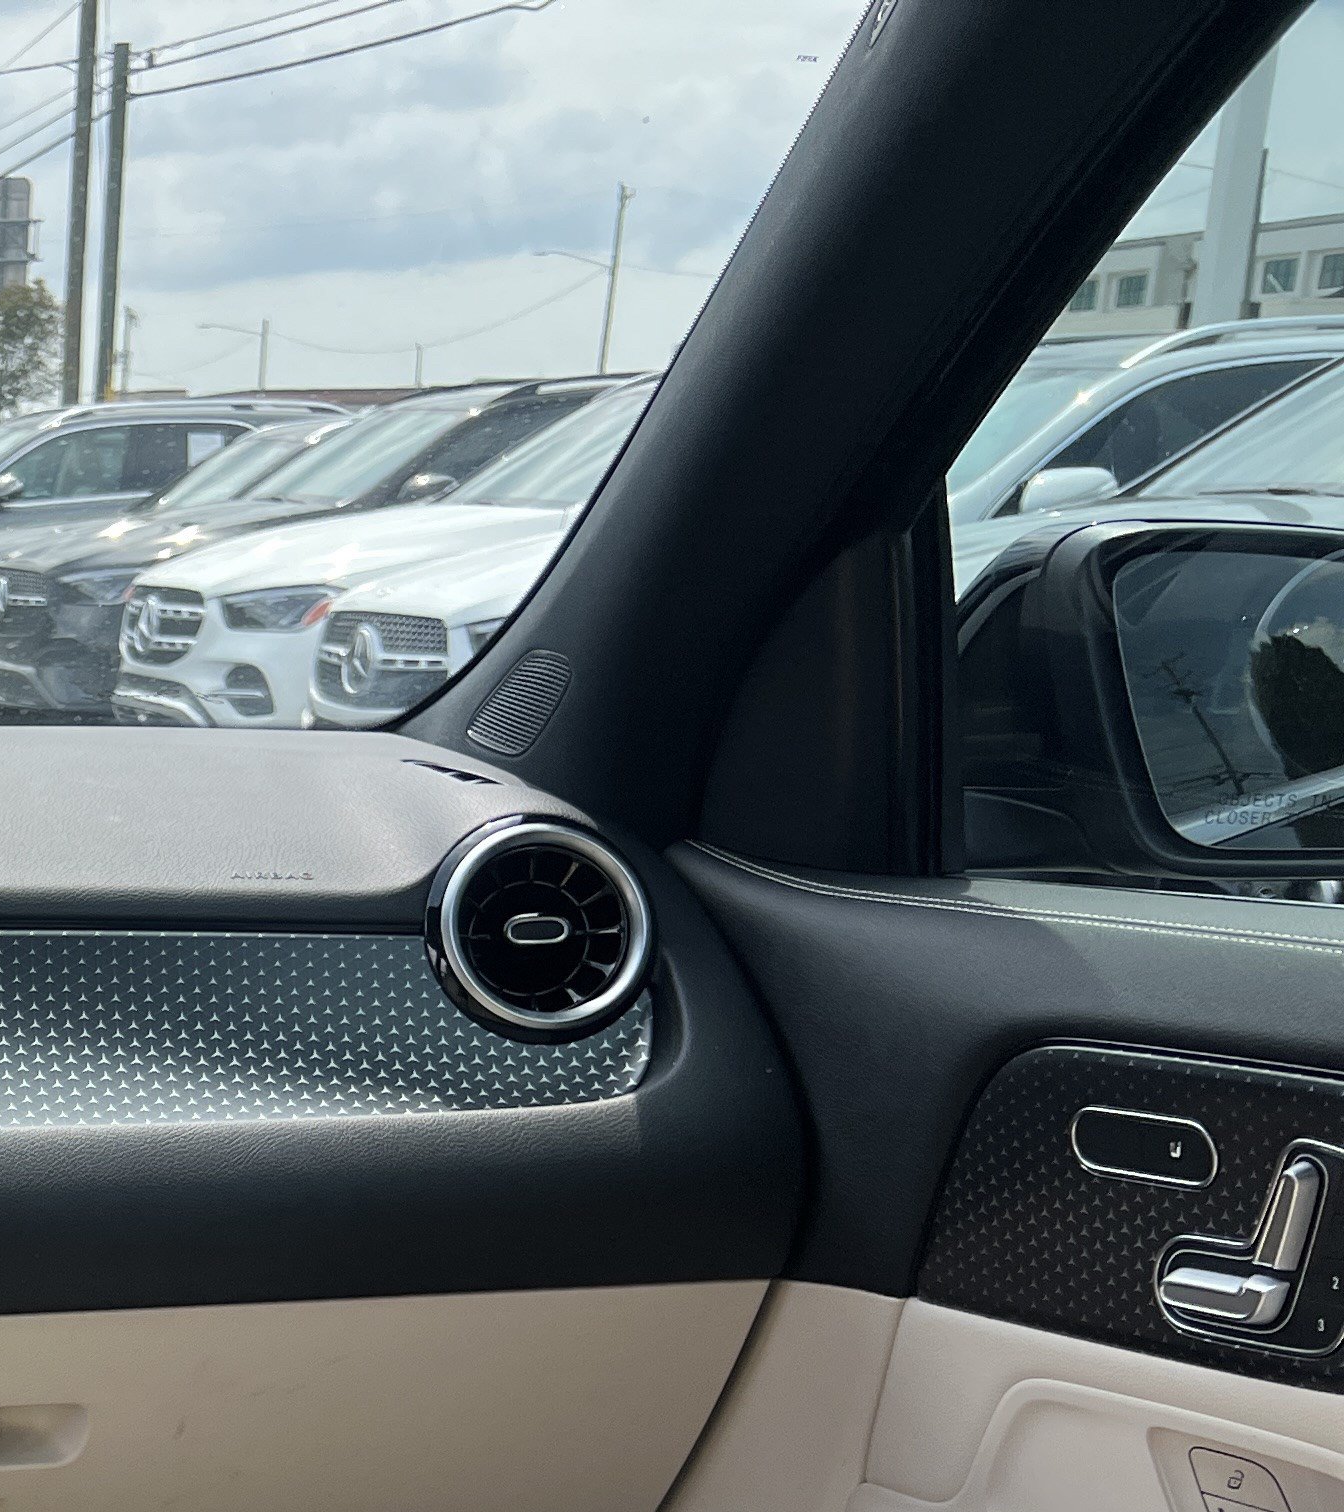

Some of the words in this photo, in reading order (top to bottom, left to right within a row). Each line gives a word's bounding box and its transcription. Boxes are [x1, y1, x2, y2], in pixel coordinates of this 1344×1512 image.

[1205, 811, 1271, 825] CLOSER
[1332, 1275, 1339, 1290] 2
[1317, 1318, 1325, 1332] 3
